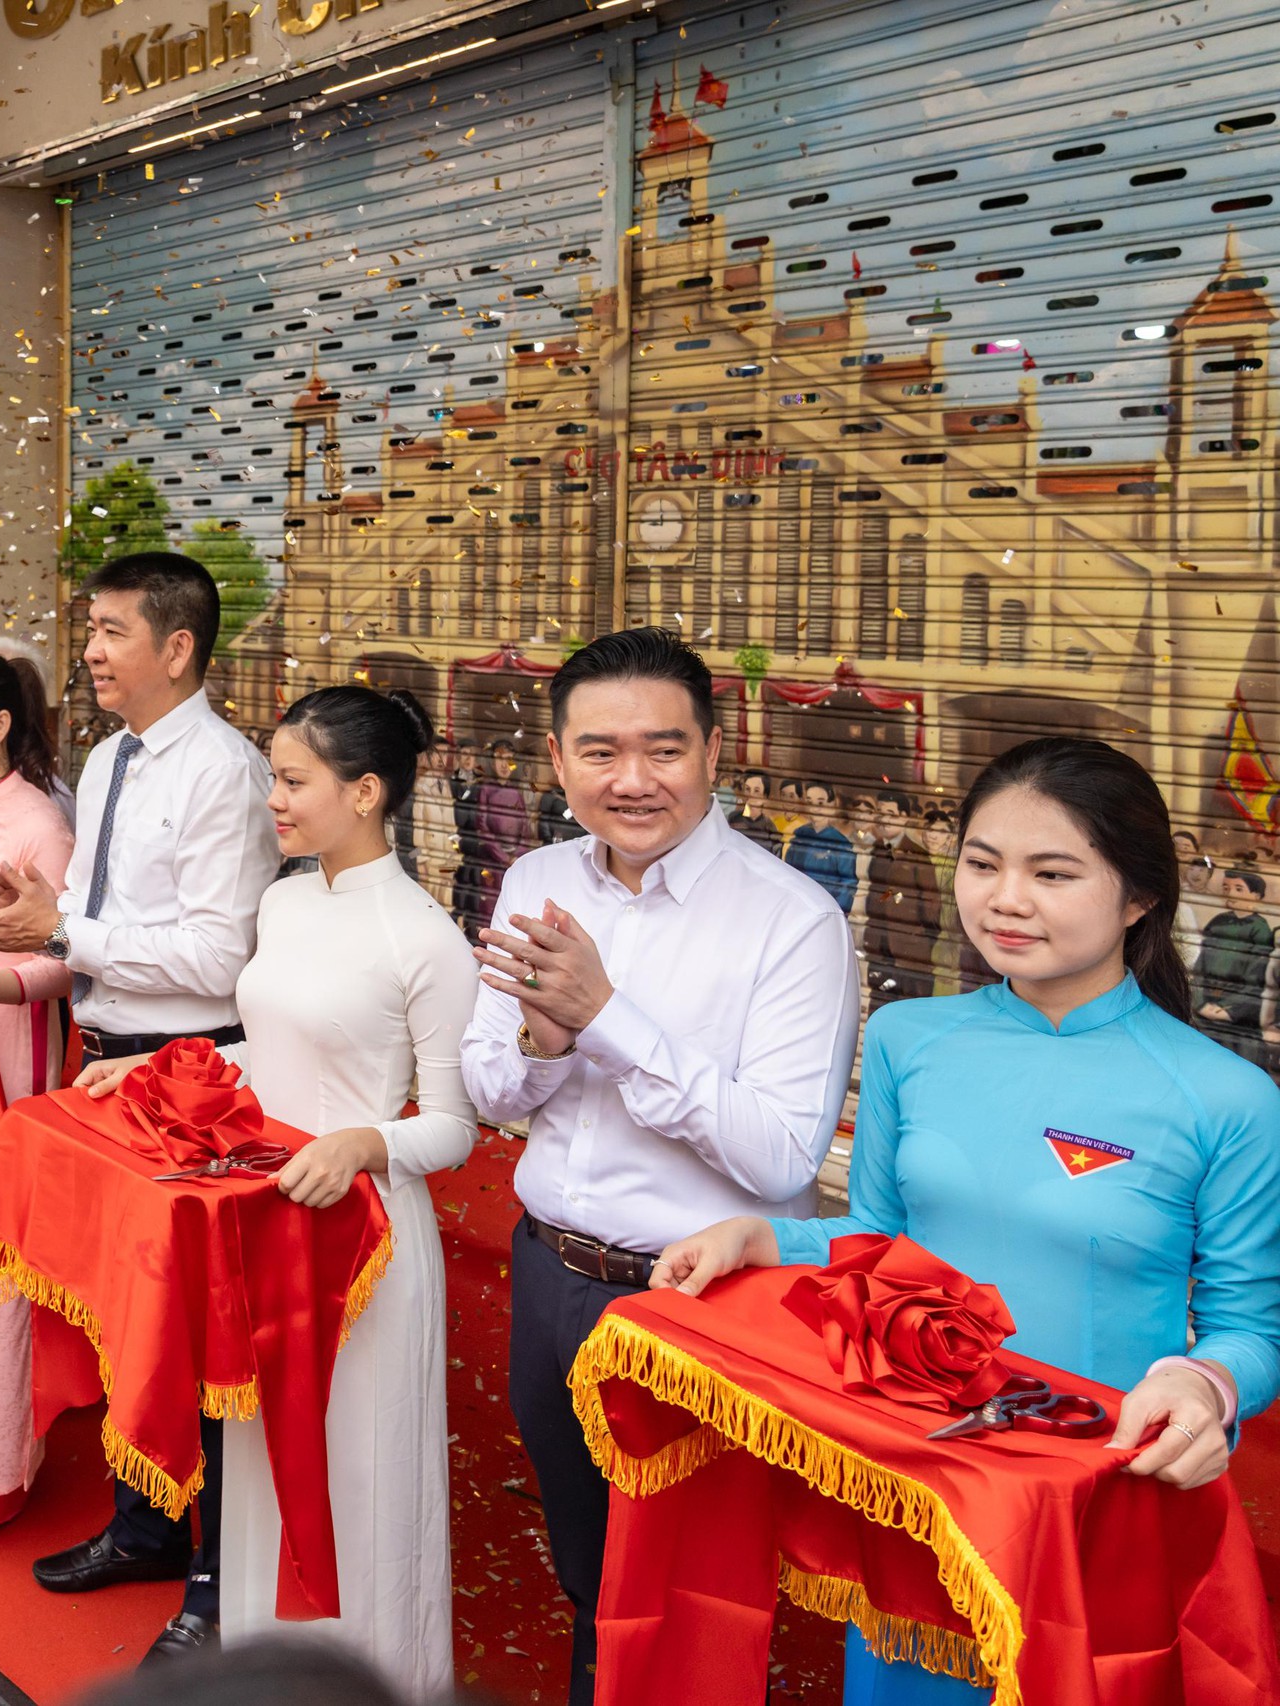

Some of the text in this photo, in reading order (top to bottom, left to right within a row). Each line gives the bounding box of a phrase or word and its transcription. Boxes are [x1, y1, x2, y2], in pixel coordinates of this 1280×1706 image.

[101, 3, 252, 104] Kính
[630, 441, 699, 483] TÂN
[1048, 1129, 1131, 1158] THANH NIÊN VIỆT NAM
